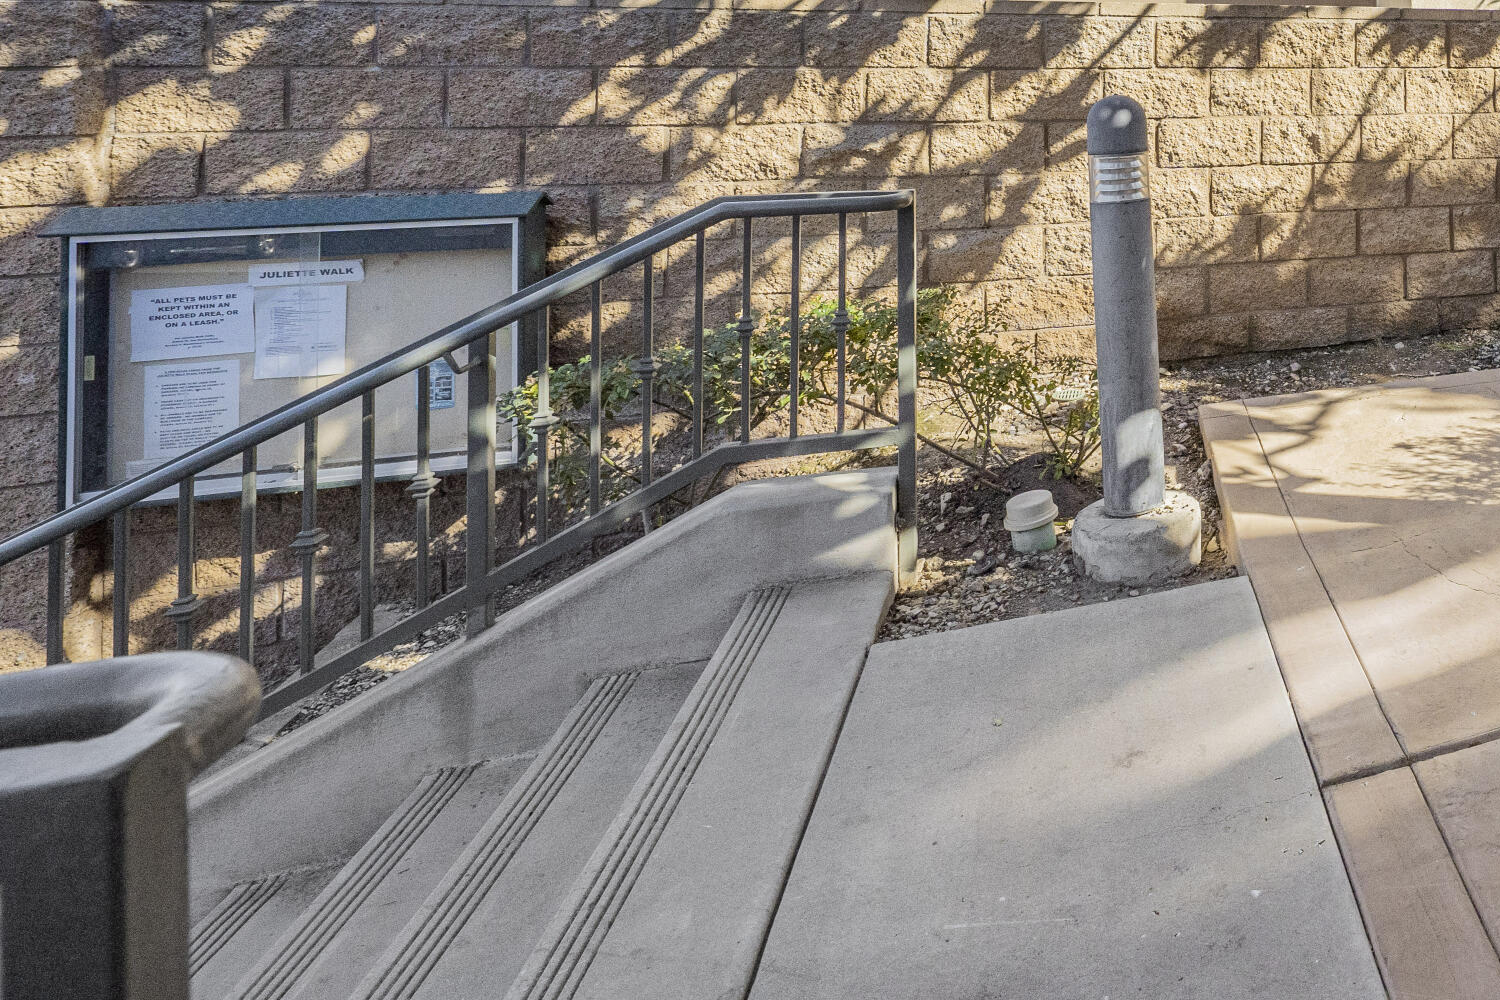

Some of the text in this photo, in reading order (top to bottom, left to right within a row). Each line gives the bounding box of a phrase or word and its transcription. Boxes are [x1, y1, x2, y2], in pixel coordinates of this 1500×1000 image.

[259, 267, 354, 279] JULIETTE WALK
[148, 312, 196, 321] ENCLOSED
